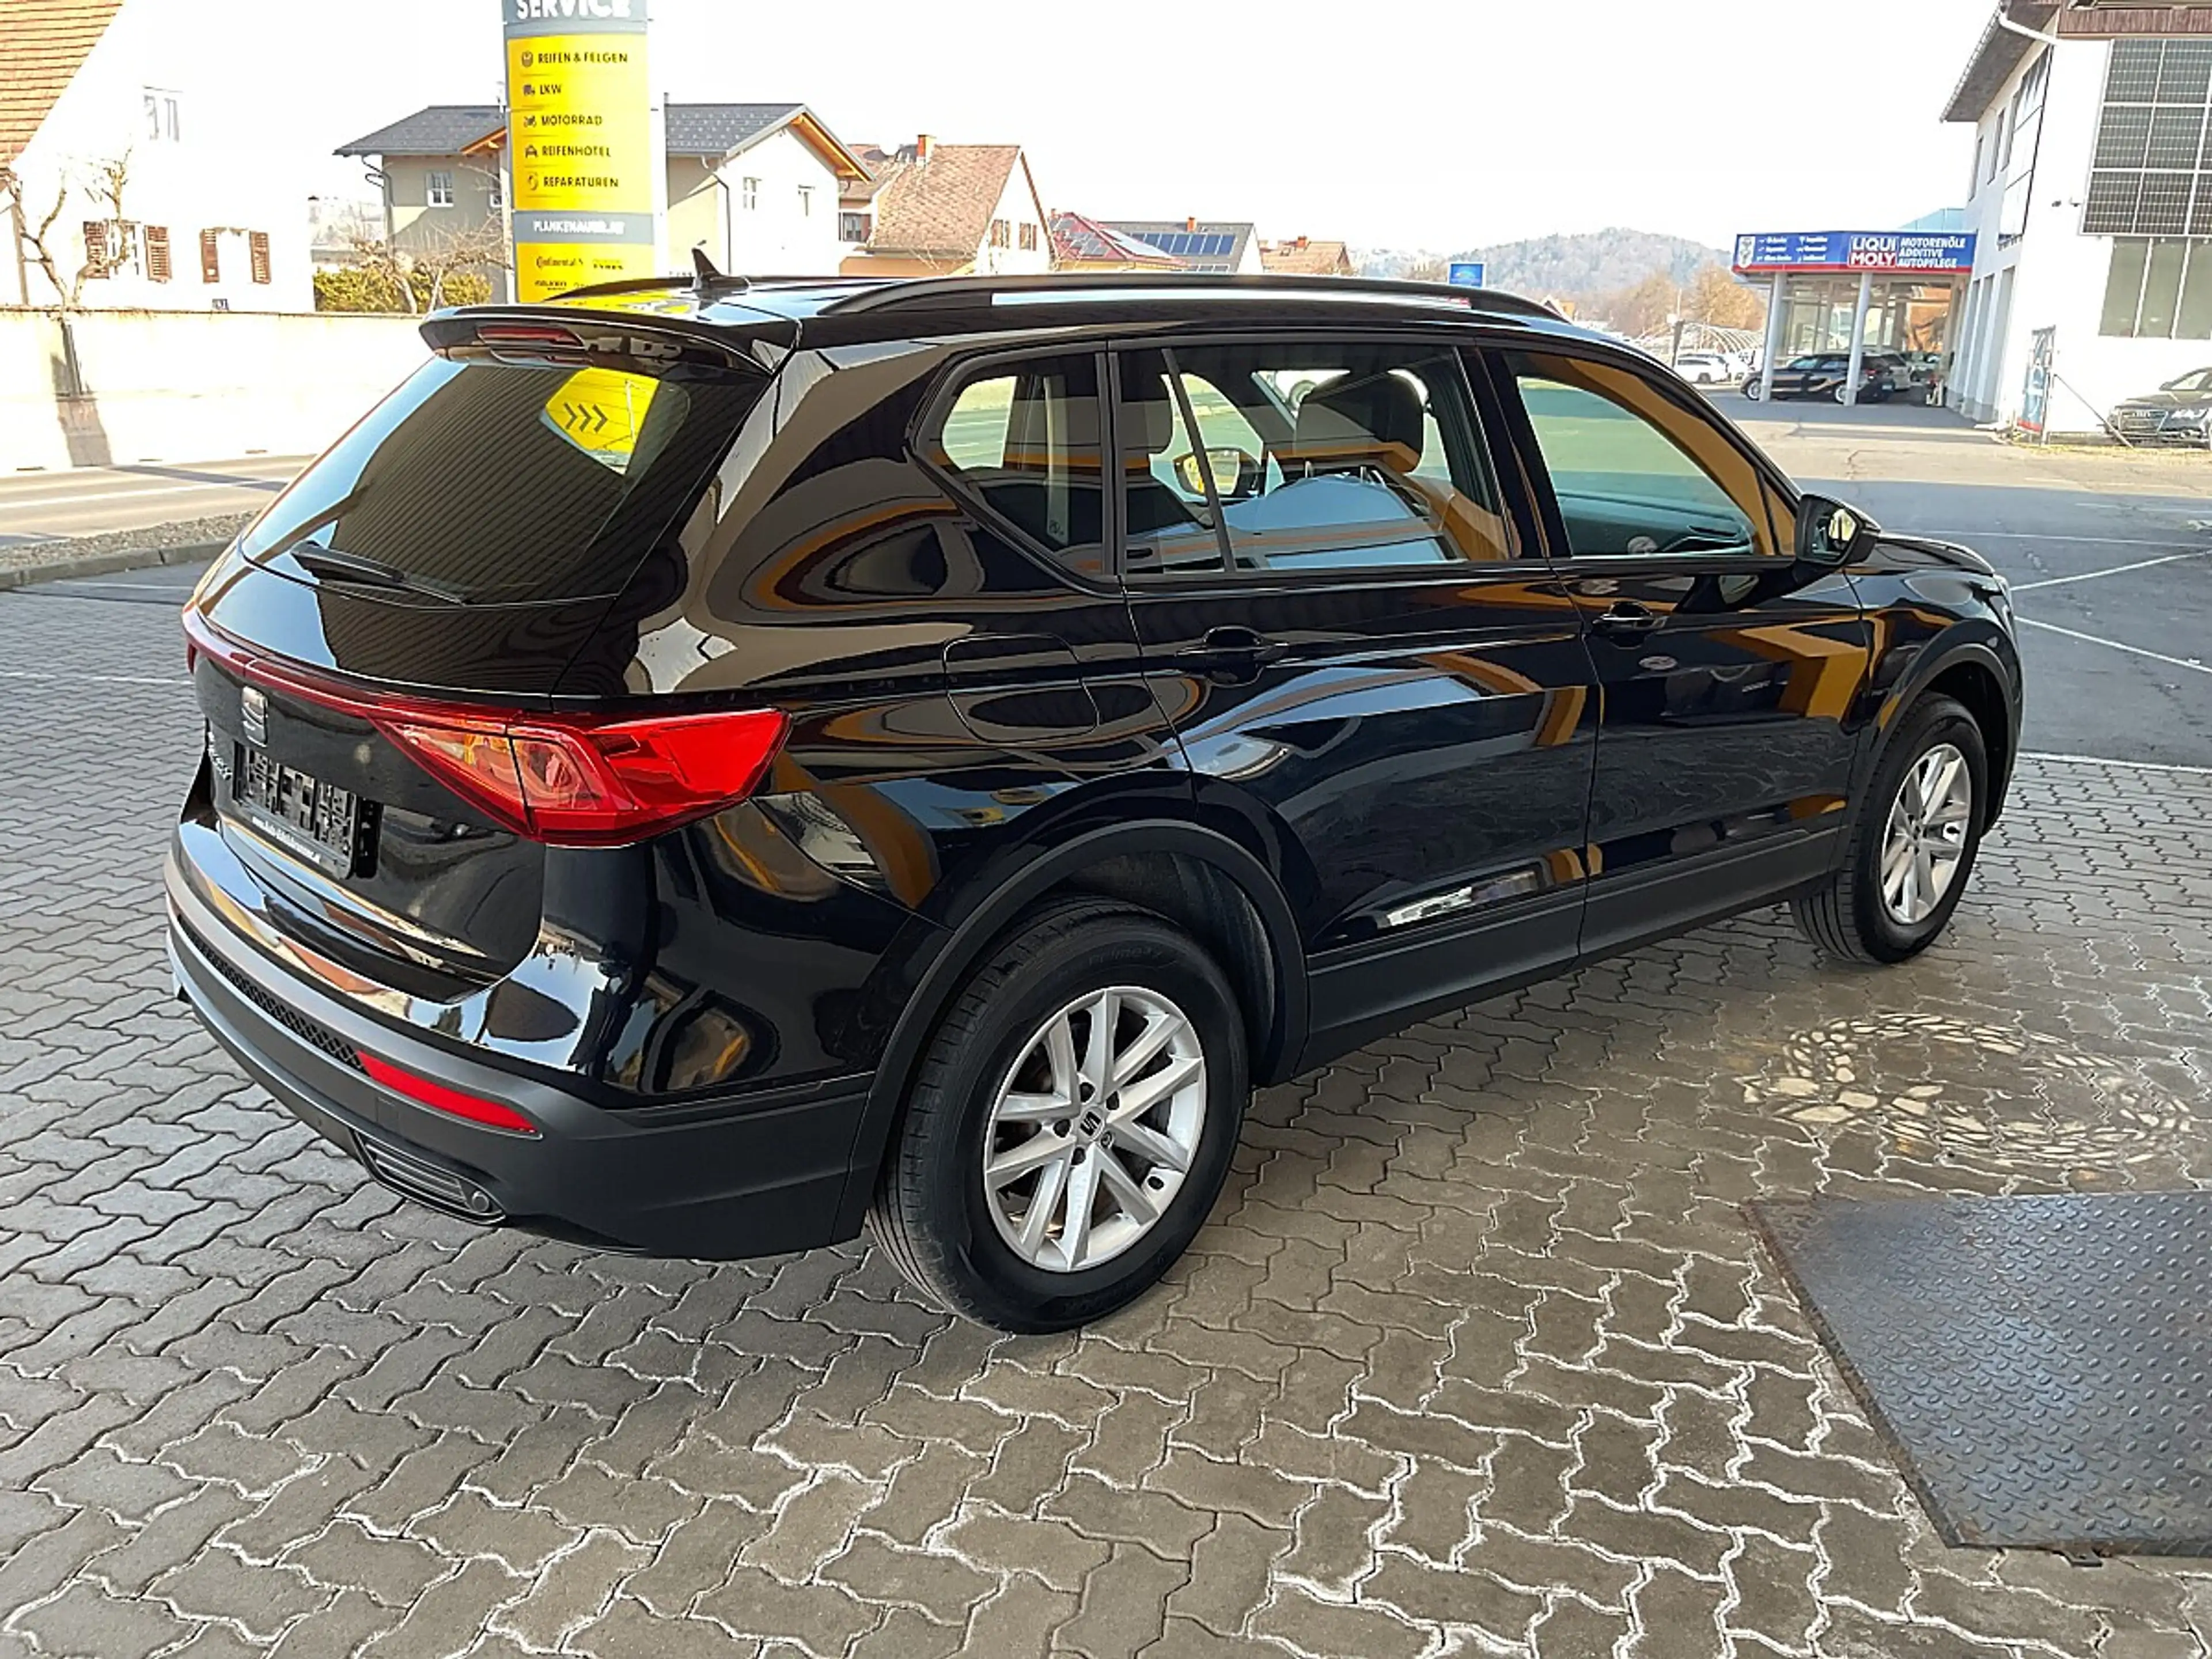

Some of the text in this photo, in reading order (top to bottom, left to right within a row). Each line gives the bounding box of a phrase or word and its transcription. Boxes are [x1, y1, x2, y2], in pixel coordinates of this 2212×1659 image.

[517, 0, 632, 19] SERVICE
[538, 52, 628, 64] REIFEN & FELGEN
[540, 84, 562, 94] LKW
[541, 115, 603, 126] MOTORRAD
[542, 146, 611, 157] REIFENHOTEL
[543, 176, 619, 187] REPARATUREN
[1852, 237, 1896, 251] LIQUI
[1901, 236, 1966, 248] MOTORENÖLE
[1899, 248, 1944, 257] ADDITIVE
[1851, 252, 1896, 266] MOLY
[1897, 258, 1958, 268] AUTOPFLEGE
